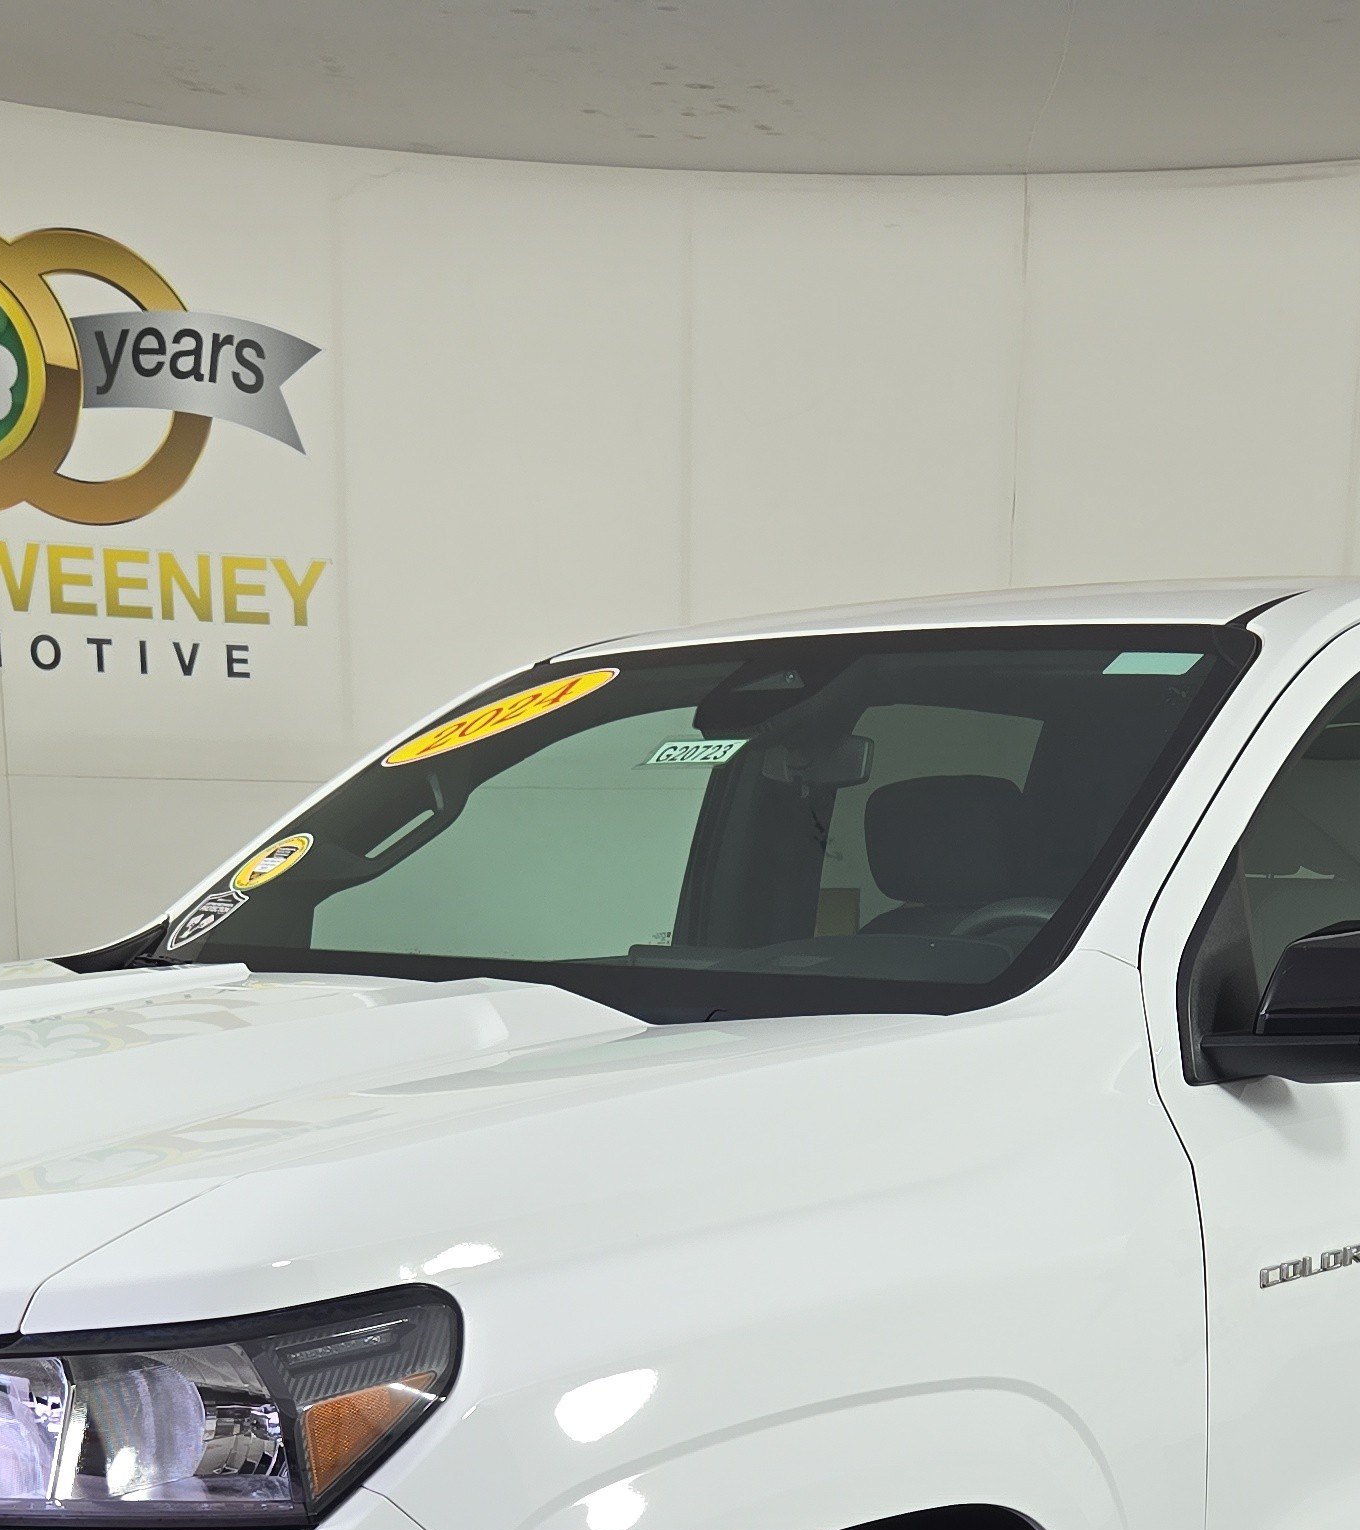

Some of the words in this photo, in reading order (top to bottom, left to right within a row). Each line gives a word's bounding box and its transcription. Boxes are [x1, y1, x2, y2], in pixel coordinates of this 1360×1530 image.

[94, 320, 268, 396] years
[416, 677, 583, 756] 2024
[656, 743, 735, 763] G20723
